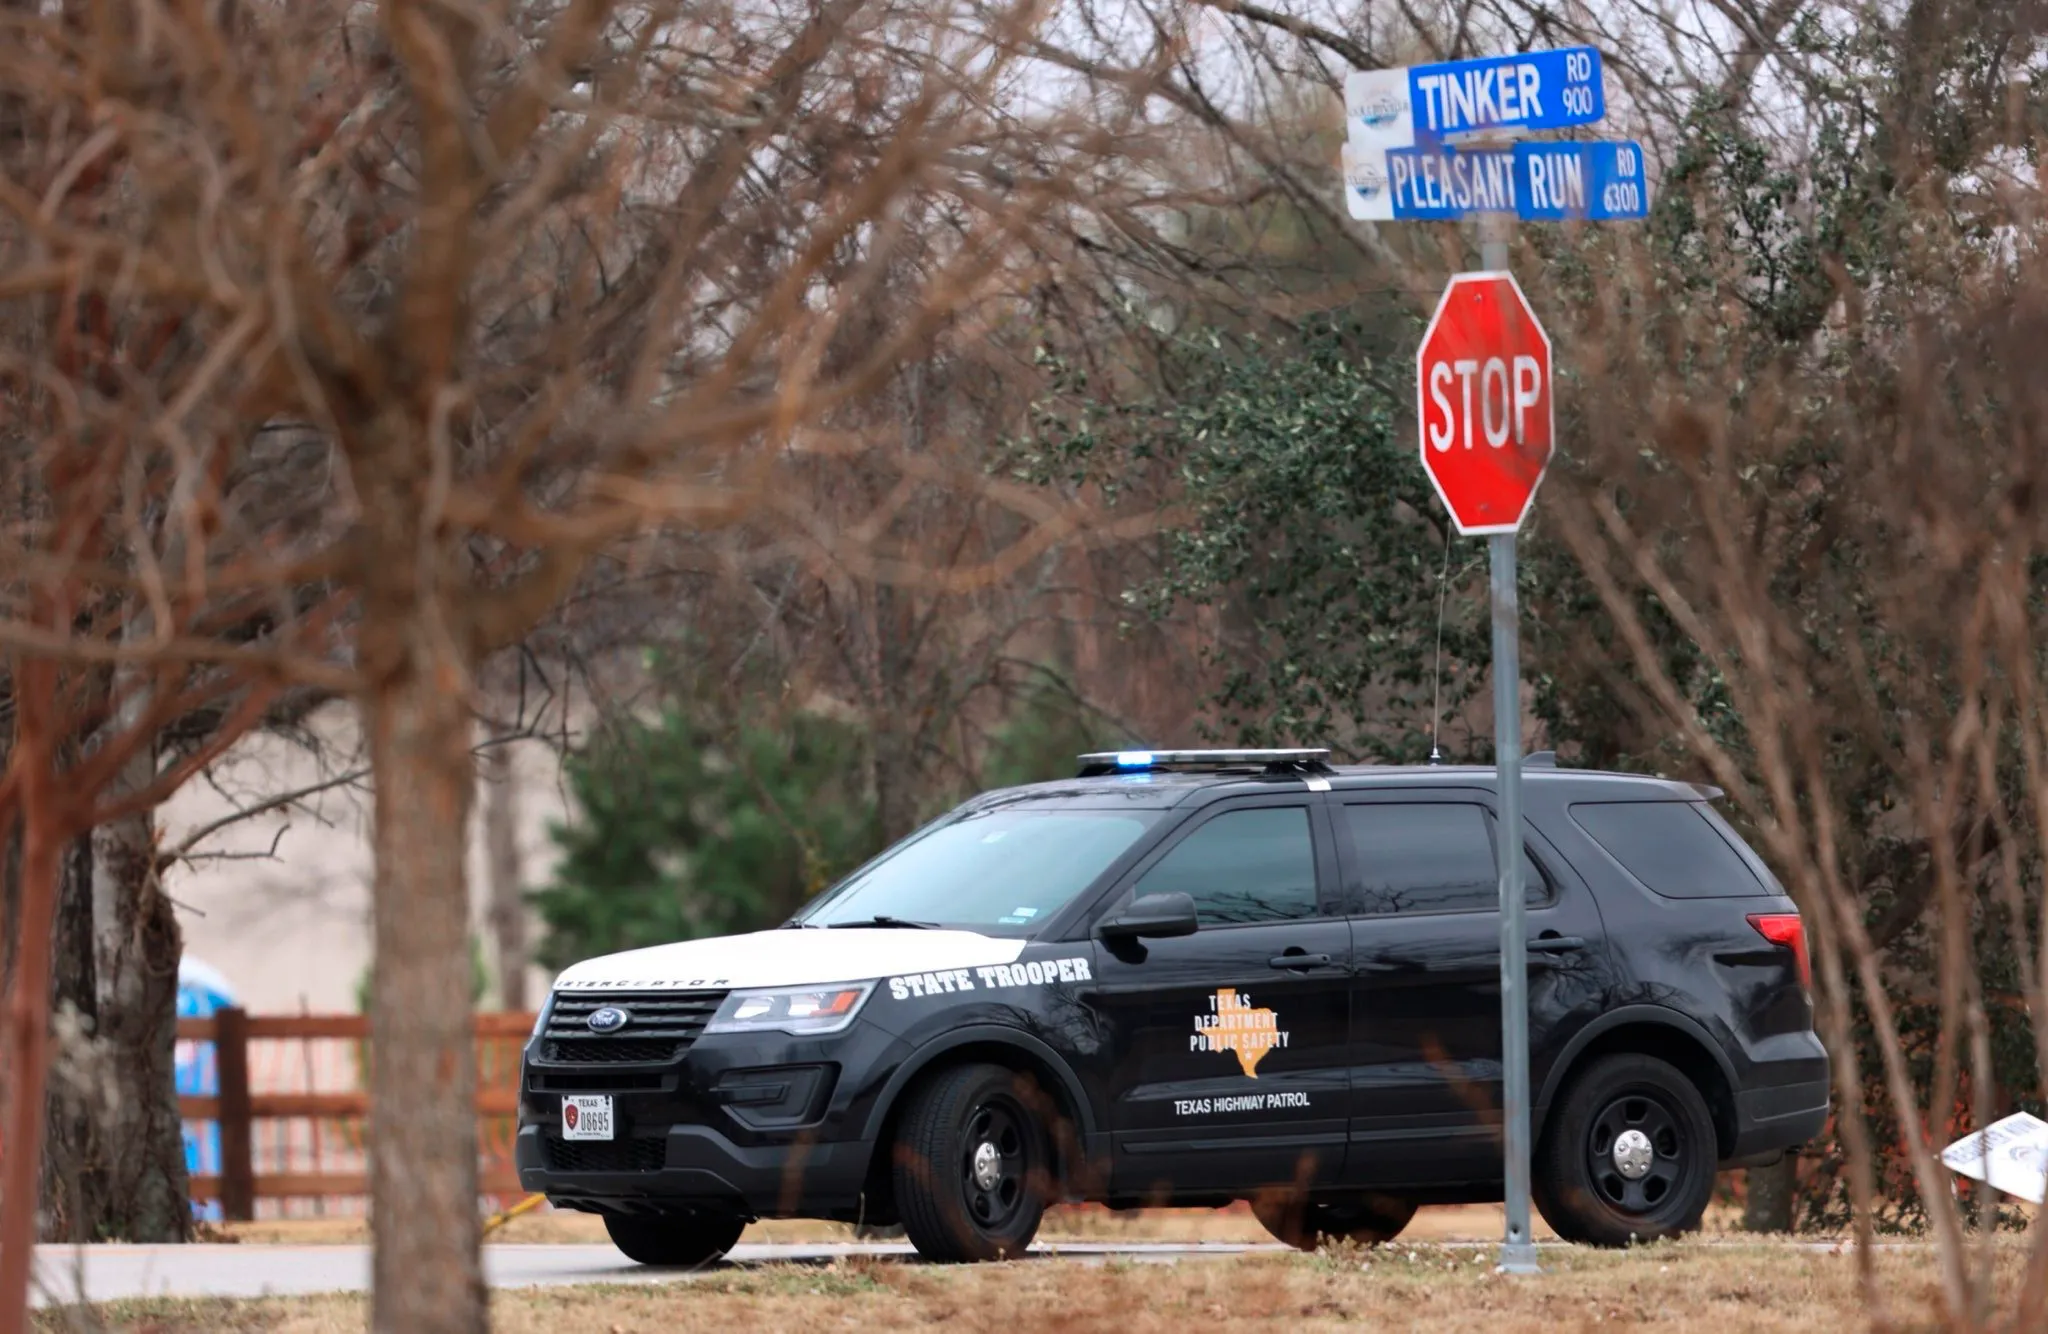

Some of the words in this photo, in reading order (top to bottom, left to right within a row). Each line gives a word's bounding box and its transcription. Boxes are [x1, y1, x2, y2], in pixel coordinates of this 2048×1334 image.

[1566, 52, 1591, 82] RD
[1418, 63, 1543, 131] TINKER
[1562, 87, 1593, 117] 900
[1616, 148, 1636, 177] RD
[1392, 154, 1516, 209] PLEASANT
[1529, 153, 1586, 209] RUN
[1603, 183, 1640, 212] 6300
[1429, 355, 1541, 453] STOP
[889, 968, 975, 1000] STATE
[976, 957, 1092, 989] TROOPER
[1208, 993, 1251, 1012] TEXAS
[1194, 1012, 1278, 1032] DEPARTMENT
[1190, 1033, 1238, 1052] PUBLIC
[1242, 1031, 1289, 1049] SAFETY
[578, 1098, 598, 1108] TEXAS
[1174, 1098, 1211, 1115] TEXAS
[1213, 1095, 1266, 1112] HIGHWAY
[1267, 1092, 1310, 1108] PATROL
[580, 1112, 609, 1131] 08695
